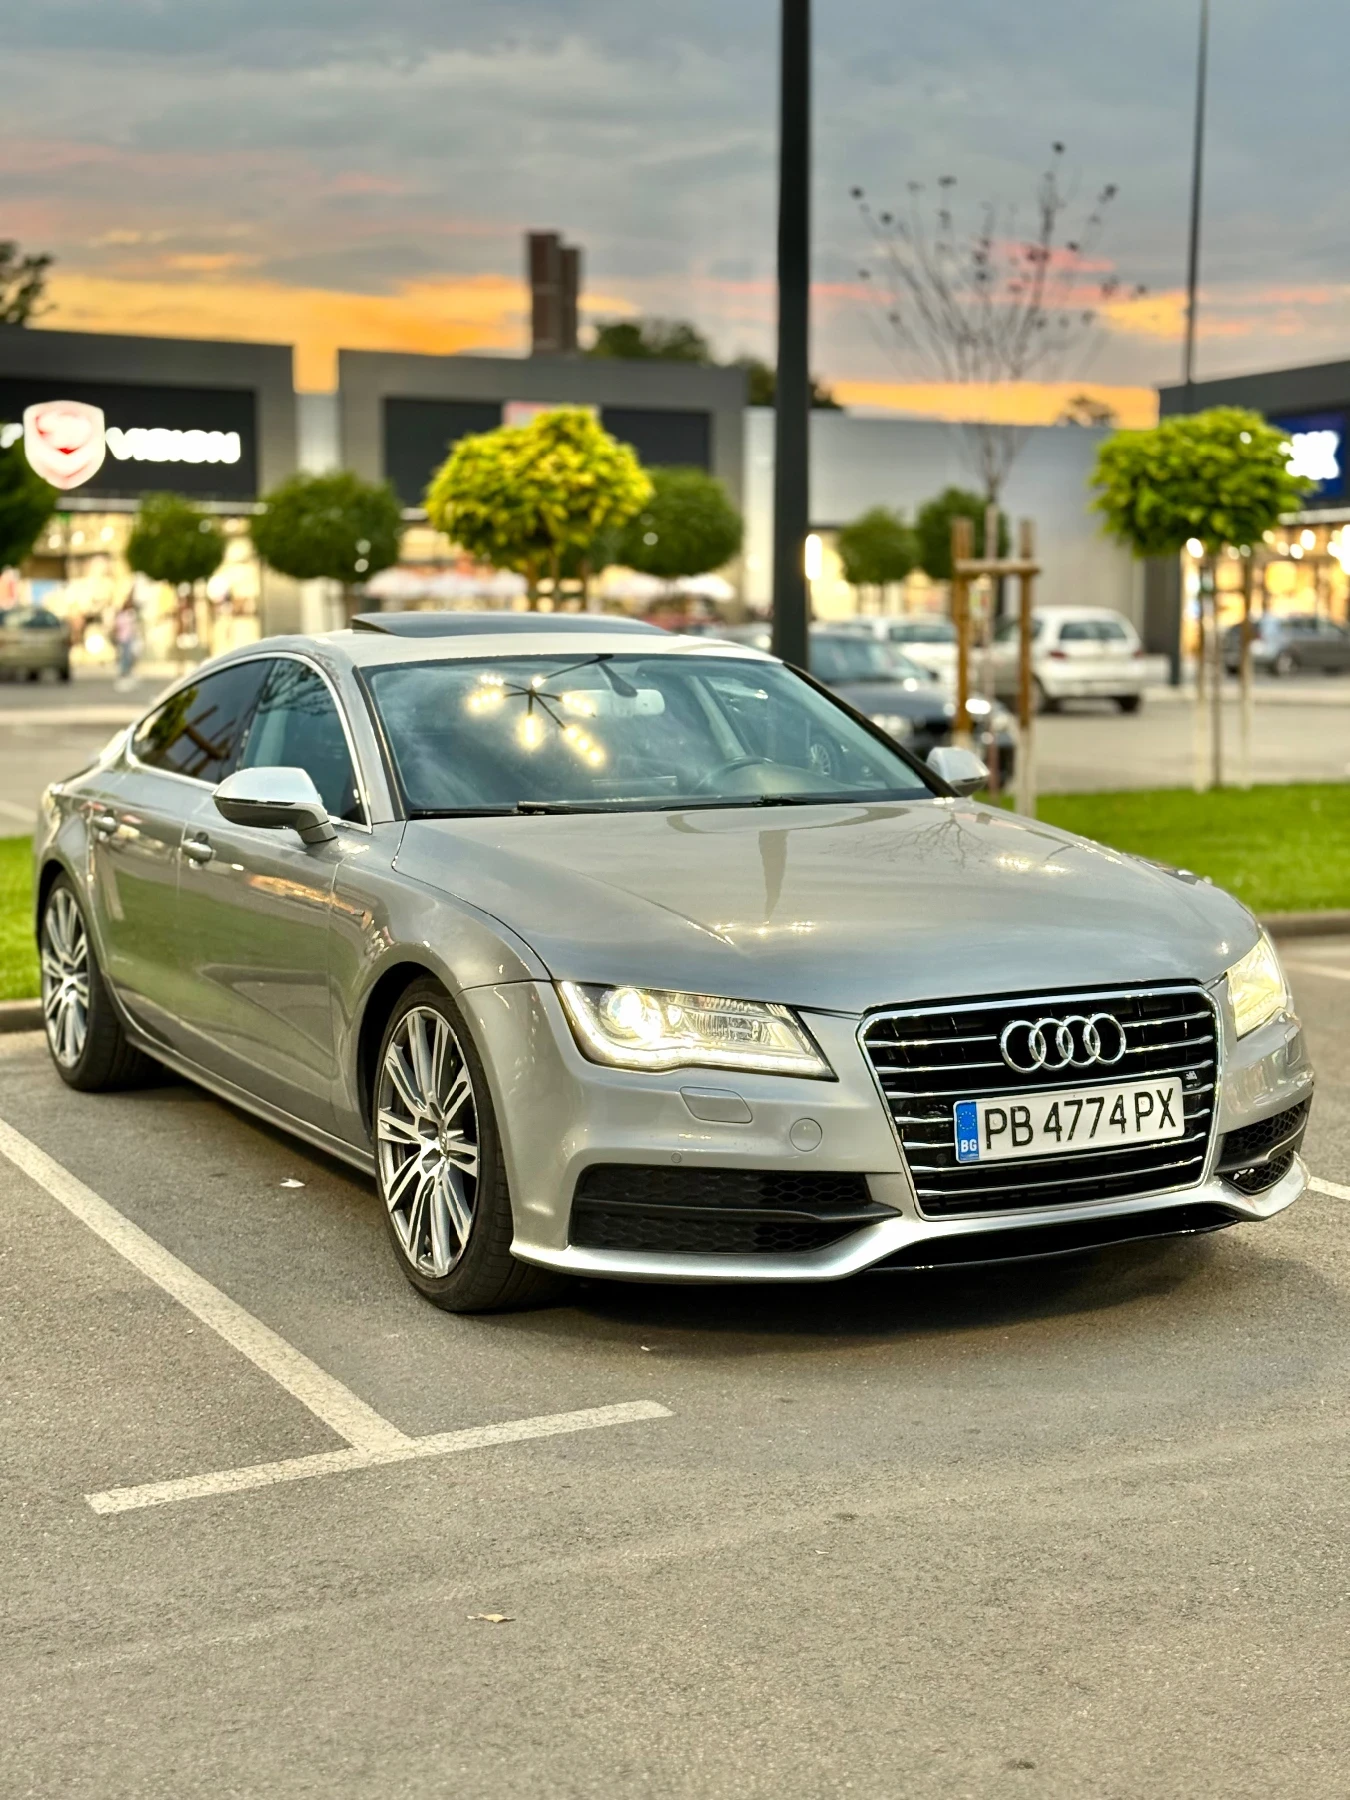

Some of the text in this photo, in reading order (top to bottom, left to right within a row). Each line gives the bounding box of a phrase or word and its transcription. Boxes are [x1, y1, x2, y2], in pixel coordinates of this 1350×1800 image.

[984, 1087, 1176, 1150] PB 4774 PX
[960, 1139, 977, 1153] BG
